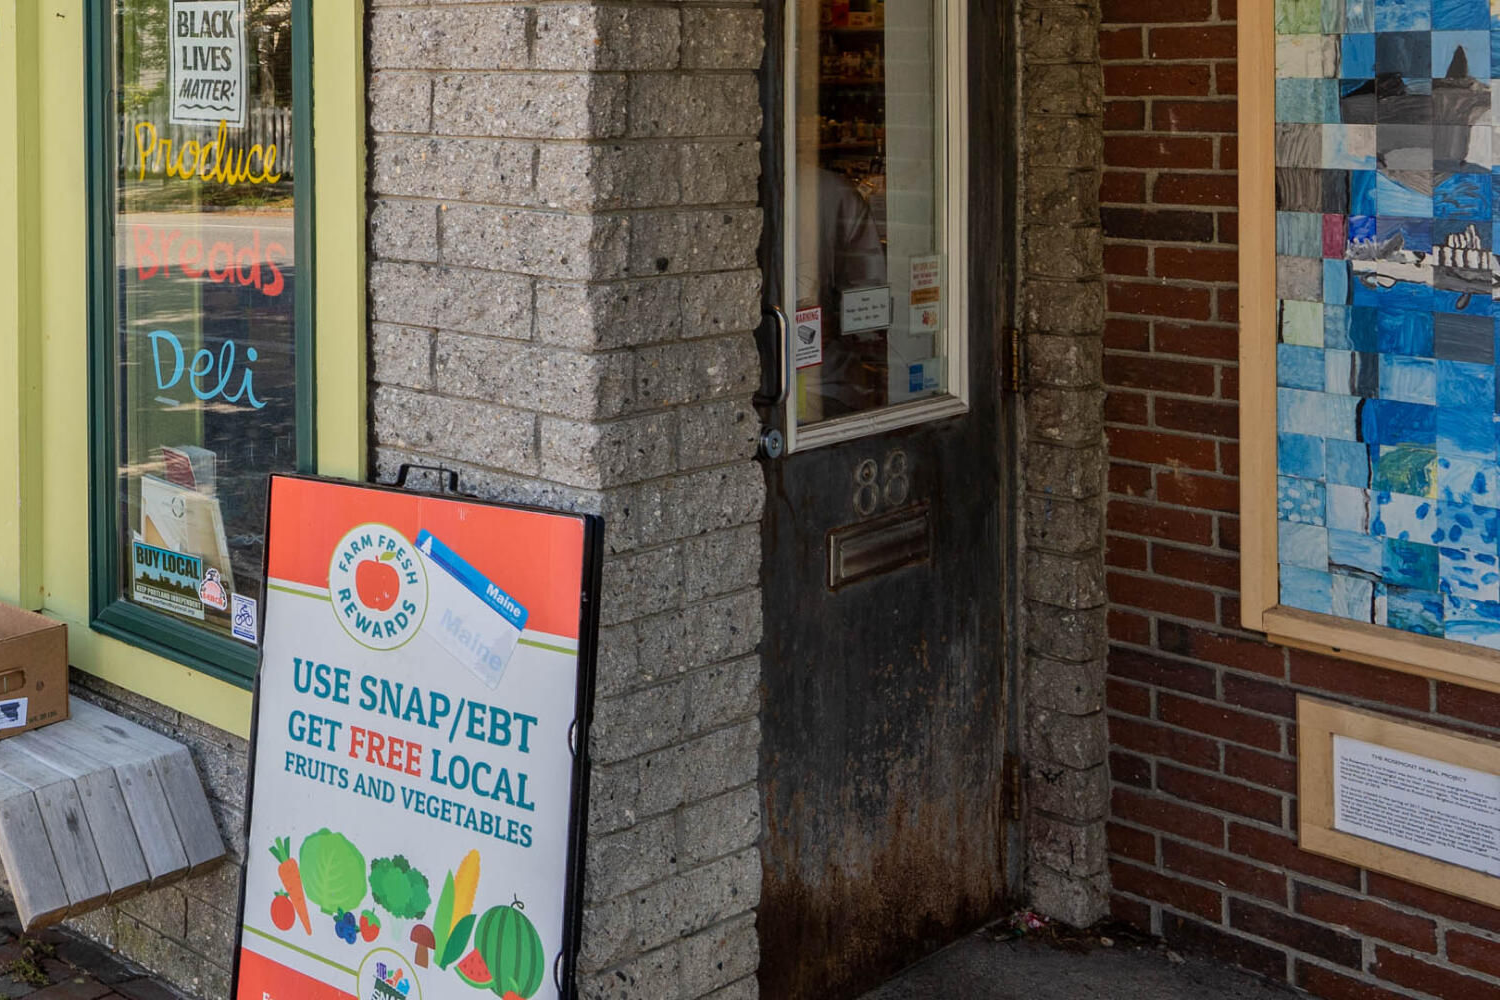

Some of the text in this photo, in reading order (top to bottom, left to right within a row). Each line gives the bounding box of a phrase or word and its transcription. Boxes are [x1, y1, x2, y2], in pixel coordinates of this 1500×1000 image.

[177, 10, 235, 39] BLACK
[182, 45, 232, 72] LIVES
[179, 78, 236, 102] MATTER!
[135, 119, 281, 186] Produce
[132, 224, 286, 297] Breads
[147, 330, 267, 409] Deli
[136, 545, 199, 581] BUY LOCAL
[339, 534, 418, 585] FARM FRESH
[136, 584, 147, 592] KEEP
[147, 588, 170, 600] PORTLAND
[171, 593, 201, 609] INDEPENDENT
[338, 588, 416, 639] REWARDS
[486, 583, 521, 617] Maine
[440, 608, 502, 672] Maine
[293, 657, 538, 753] USE SNAP/EBT
[288, 710, 535, 811] GET FREE LOCAL
[1372, 753, 1467, 783] THE ROSEMONT MURAL PROJECT
[284, 750, 533, 848] FRUITS AND VEGETABLES
